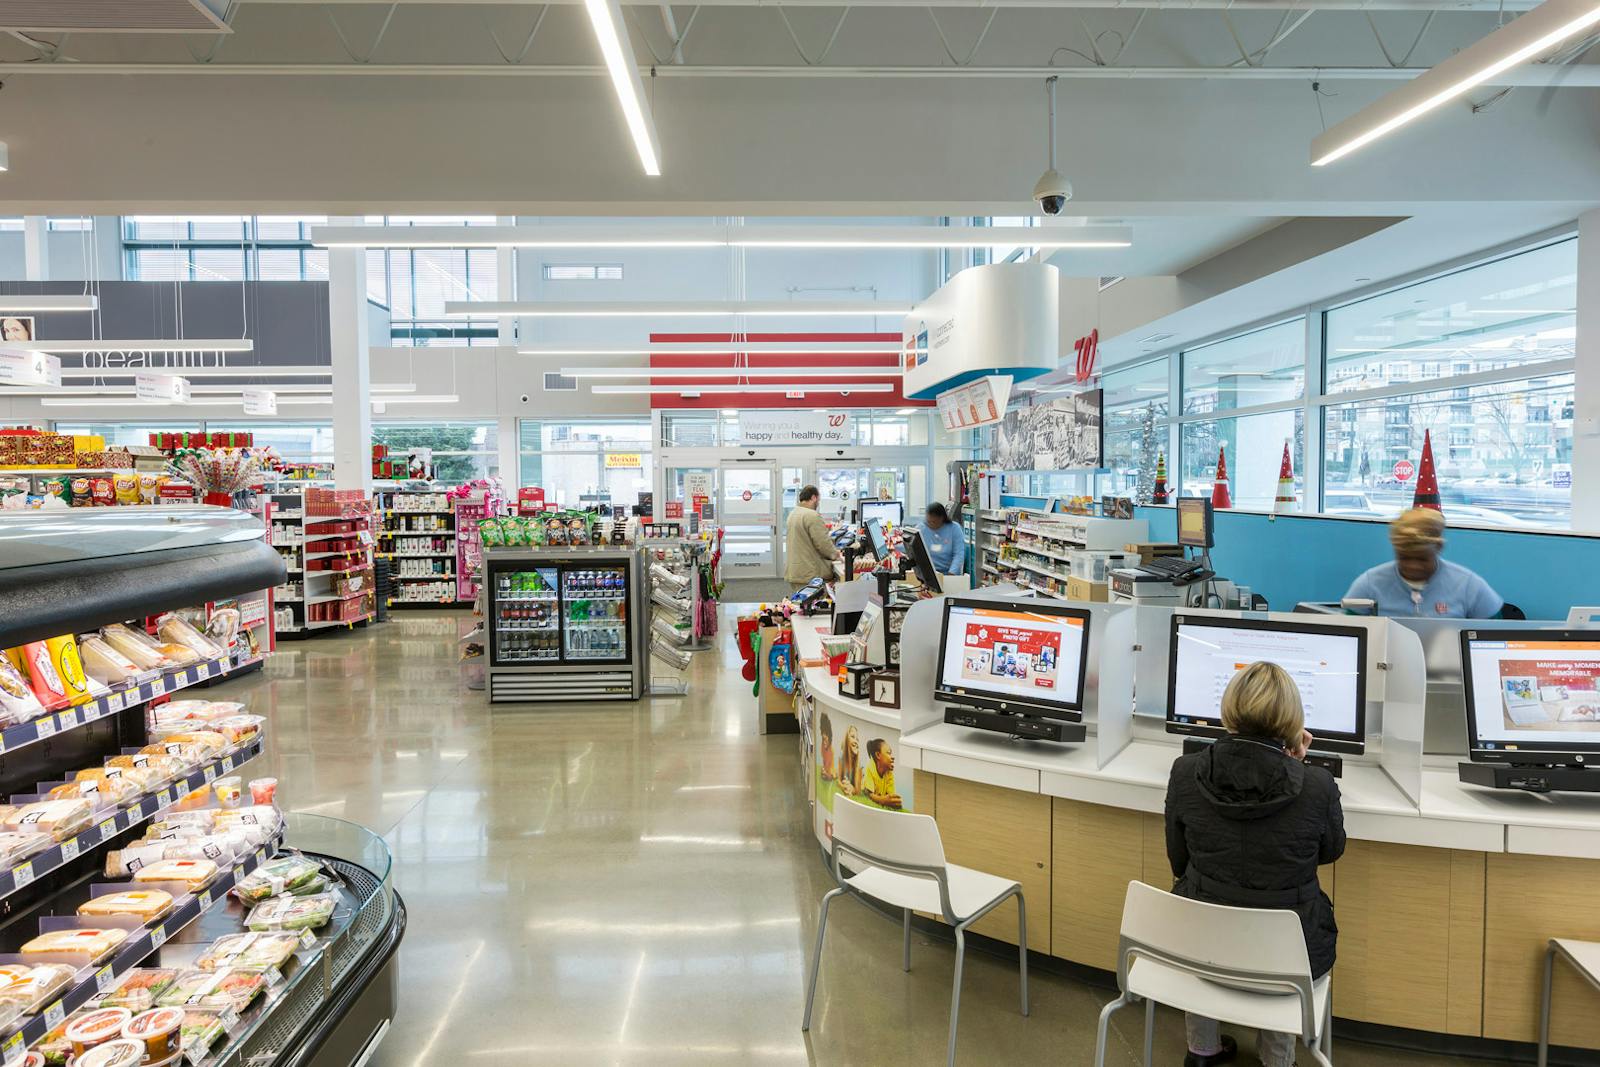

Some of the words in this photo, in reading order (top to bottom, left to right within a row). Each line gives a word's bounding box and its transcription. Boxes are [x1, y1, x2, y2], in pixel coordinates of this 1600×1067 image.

[35, 361, 43, 375] 4
[174, 384, 181, 395] 3
[777, 422, 793, 431] you
[745, 431, 772, 441] happy
[791, 431, 823, 441] healthy
[824, 431, 844, 441] day.
[1394, 466, 1413, 475] STOP
[1119, 582, 1132, 593] photo
